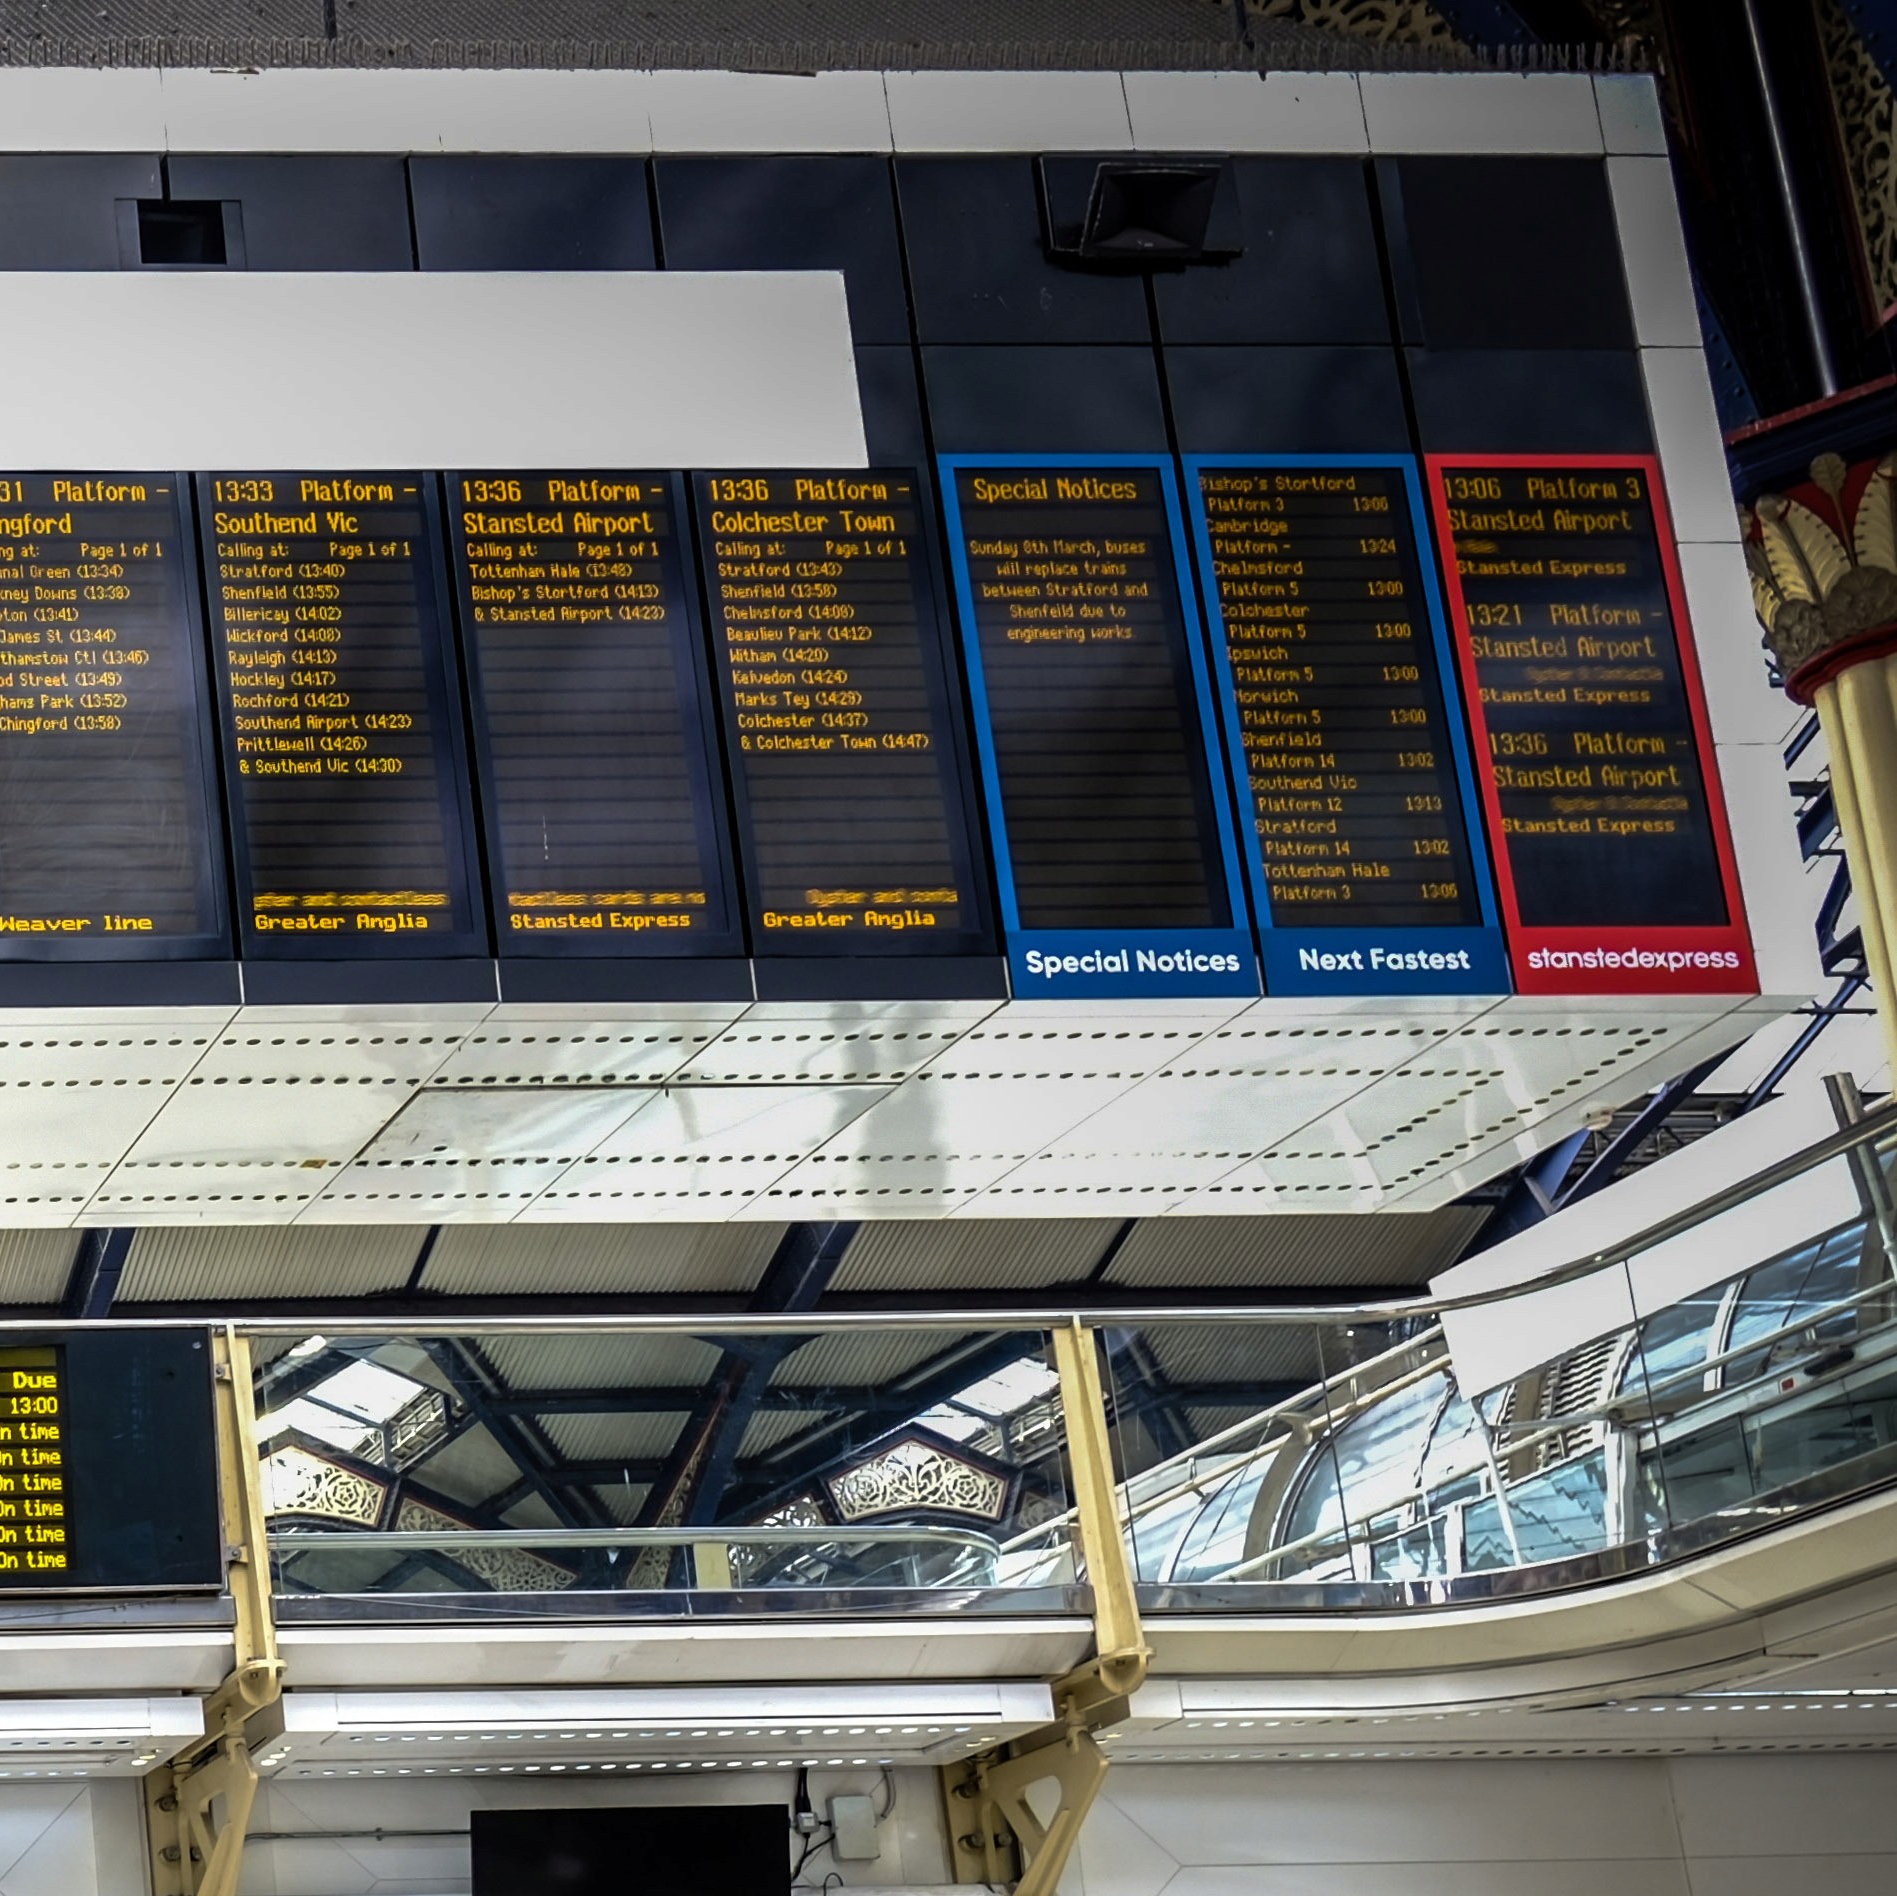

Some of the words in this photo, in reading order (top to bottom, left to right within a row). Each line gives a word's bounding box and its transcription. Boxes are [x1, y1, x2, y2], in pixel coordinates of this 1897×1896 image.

[973, 477, 1049, 504] Special
[1055, 478, 1137, 500] Notices
[711, 510, 829, 534] Colchester
[840, 510, 896, 533] Town
[1026, 950, 1128, 977] Special
[1137, 950, 1240, 975] Notices
[1300, 949, 1364, 970] Next
[1372, 948, 1470, 971] Fastest
[1529, 948, 1739, 971] stanstedexpress
[12, 1371, 57, 1390] Due
[10, 1395, 59, 1415] 13:00
[18, 1422, 60, 1441] time
[20, 1447, 62, 1466] time
[21, 1473, 63, 1492] time
[23, 1499, 64, 1518] time
[24, 1525, 66, 1543] time
[25, 1551, 67, 1569] time
